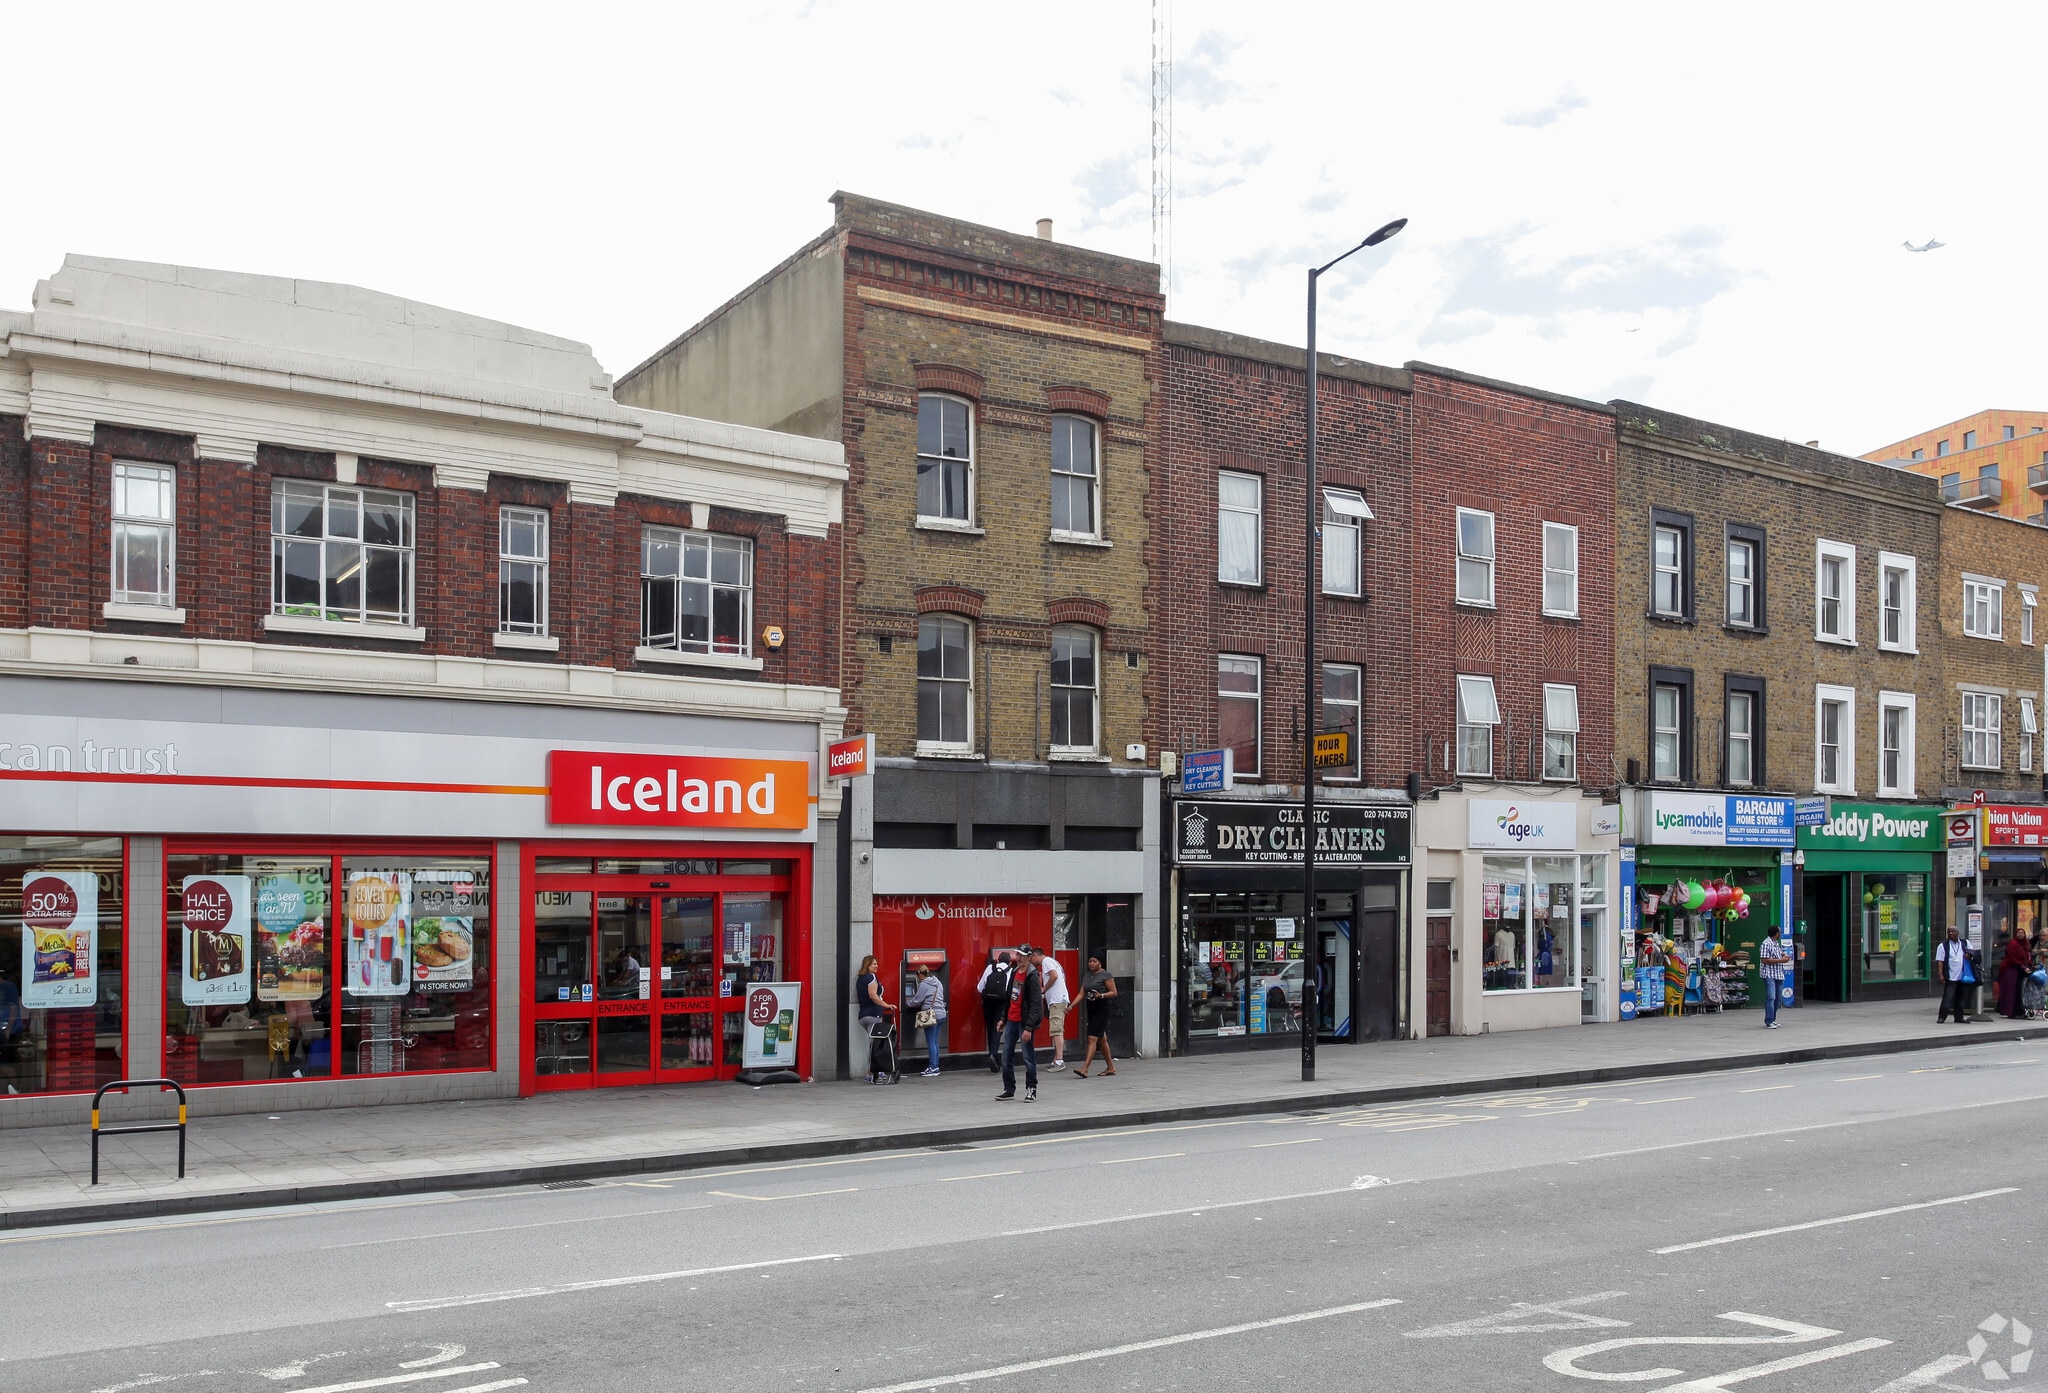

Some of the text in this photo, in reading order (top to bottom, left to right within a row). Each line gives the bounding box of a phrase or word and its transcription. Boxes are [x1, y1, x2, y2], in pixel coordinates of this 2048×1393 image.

[1317, 739, 1340, 751] HOUR
[0, 739, 179, 776] can trust
[831, 747, 863, 767] Iceland
[1186, 753, 1222, 767] 2 HOURS
[1185, 765, 1222, 775] DRY CLEANING
[591, 765, 775, 815] Iceland
[1185, 780, 1222, 790] KEY CUTTING
[1973, 792, 1984, 803] M
[1735, 800, 1785, 816] BARGAIN
[1364, 810, 1408, 819] 020 7474 3705
[1656, 809, 1723, 830] Lycamobile
[1735, 815, 1777, 826] HOME STORE
[1796, 812, 1823, 822] ARGAIN
[2011, 811, 2042, 826] Nation
[1872, 813, 1929, 838] Power
[1995, 827, 2019, 835] SPORTS
[1217, 825, 1265, 849] DRY
[1245, 852, 1259, 861] KEY
[1260, 852, 1288, 861] CUTTING
[1293, 853, 1318, 861] REPS
[1318, 853, 1324, 861] &
[1324, 853, 1363, 861] ALTERATION
[261, 892, 300, 901] as seen
[356, 885, 386, 903] LOVELY
[31, 892, 69, 911] 50%
[186, 894, 227, 907] HALF
[26, 910, 72, 918] EXTRA FREE
[265, 903, 296, 914] on TV
[356, 904, 386, 921] LOLLIES
[938, 902, 1008, 919] Santander
[186, 909, 226, 921] PRICE
[44, 940, 65, 951] McCain
[1232, 942, 1237, 950] 2
[76, 950, 88, 959] EXTRA
[76, 959, 89, 970] FREE
[758, 994, 773, 1002] FOR
[598, 1002, 648, 1014] ENTRANCE
[663, 1000, 711, 1011] ENTRANCE
[753, 1002, 769, 1018] £5
